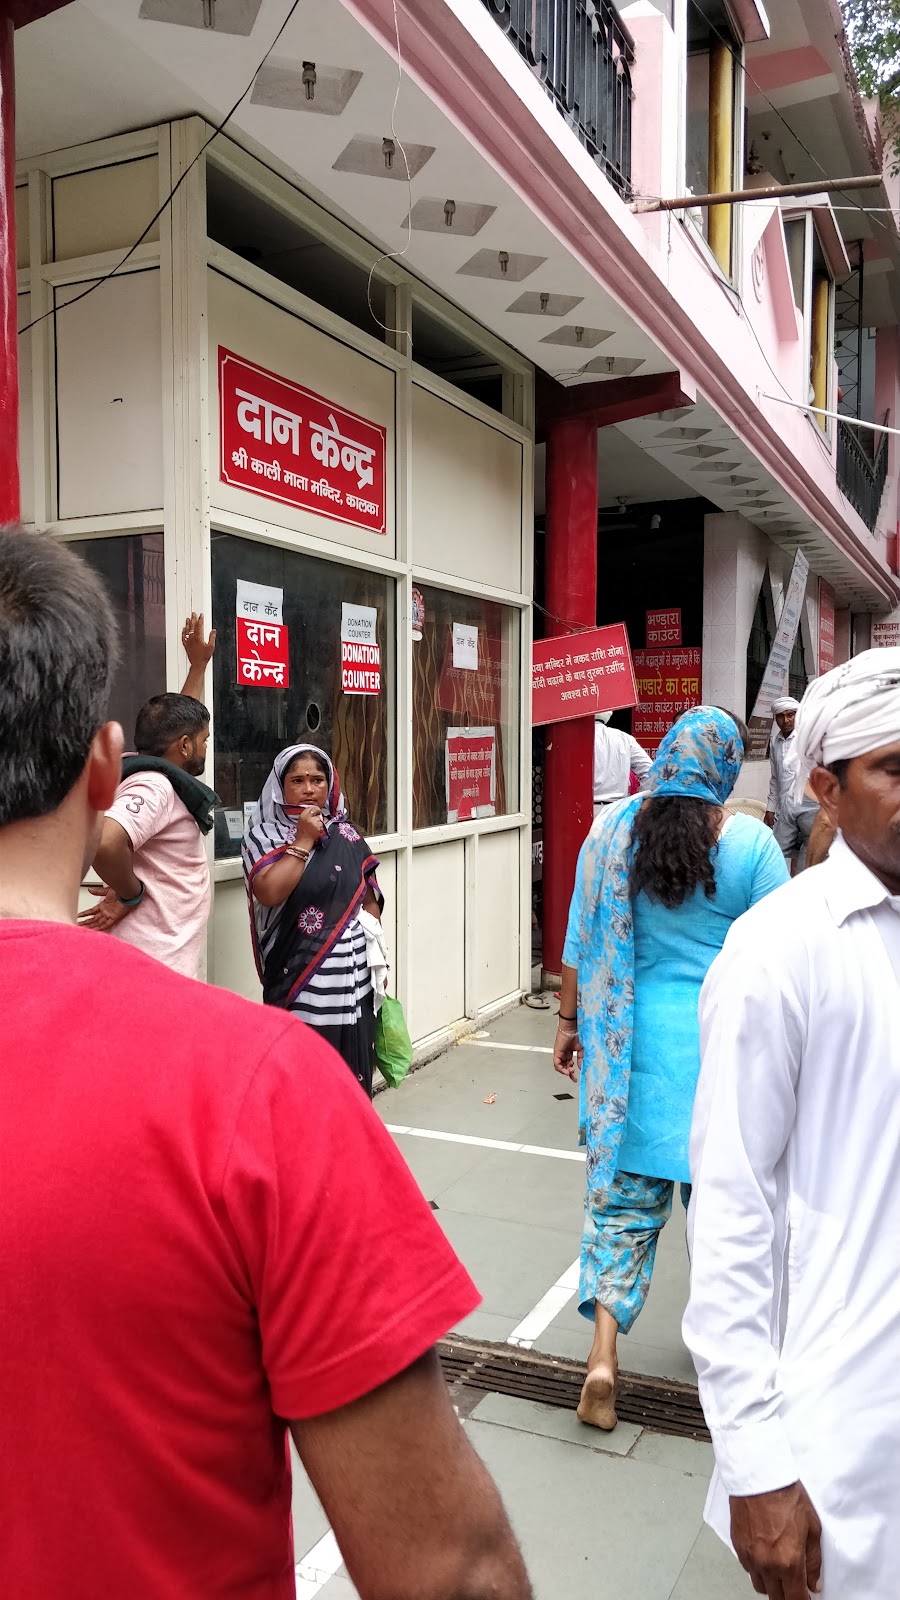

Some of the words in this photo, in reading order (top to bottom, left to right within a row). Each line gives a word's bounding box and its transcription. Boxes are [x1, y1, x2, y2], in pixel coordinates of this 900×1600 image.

[235, 388, 302, 456] दान
[309, 413, 376, 490] केन्द्र
[231, 447, 248, 470] श्री
[250, 459, 281, 482] काली
[283, 469, 309, 492] माता
[310, 478, 344, 505] मन्दिर,
[345, 493, 380, 517] कालका
[243, 600, 259, 614] दान
[347, 618, 373, 628] DONATION
[647, 612, 680, 627] भण्डारा
[244, 621, 281, 648] दान
[347, 629, 372, 639] COUNTER
[647, 626, 680, 642] काउंटर
[342, 644, 380, 665] DONATION
[607, 645, 625, 658] सोना
[634, 651, 645, 667] सभी
[665, 652, 671, 666] से
[693, 649, 700, 664] कि
[240, 650, 286, 685] केन्द्र
[565, 671, 573, 682] के
[573, 669, 586, 680] बाद
[342, 669, 381, 690] COUNTER
[665, 678, 679, 696] का
[682, 677, 699, 695] दान
[560, 689, 581, 701] अवश्य
[581, 685, 589, 697] ले
[654, 698, 674, 713] काउंटर
[674, 701, 683, 713] पर
[125, 795, 145, 814] 3
